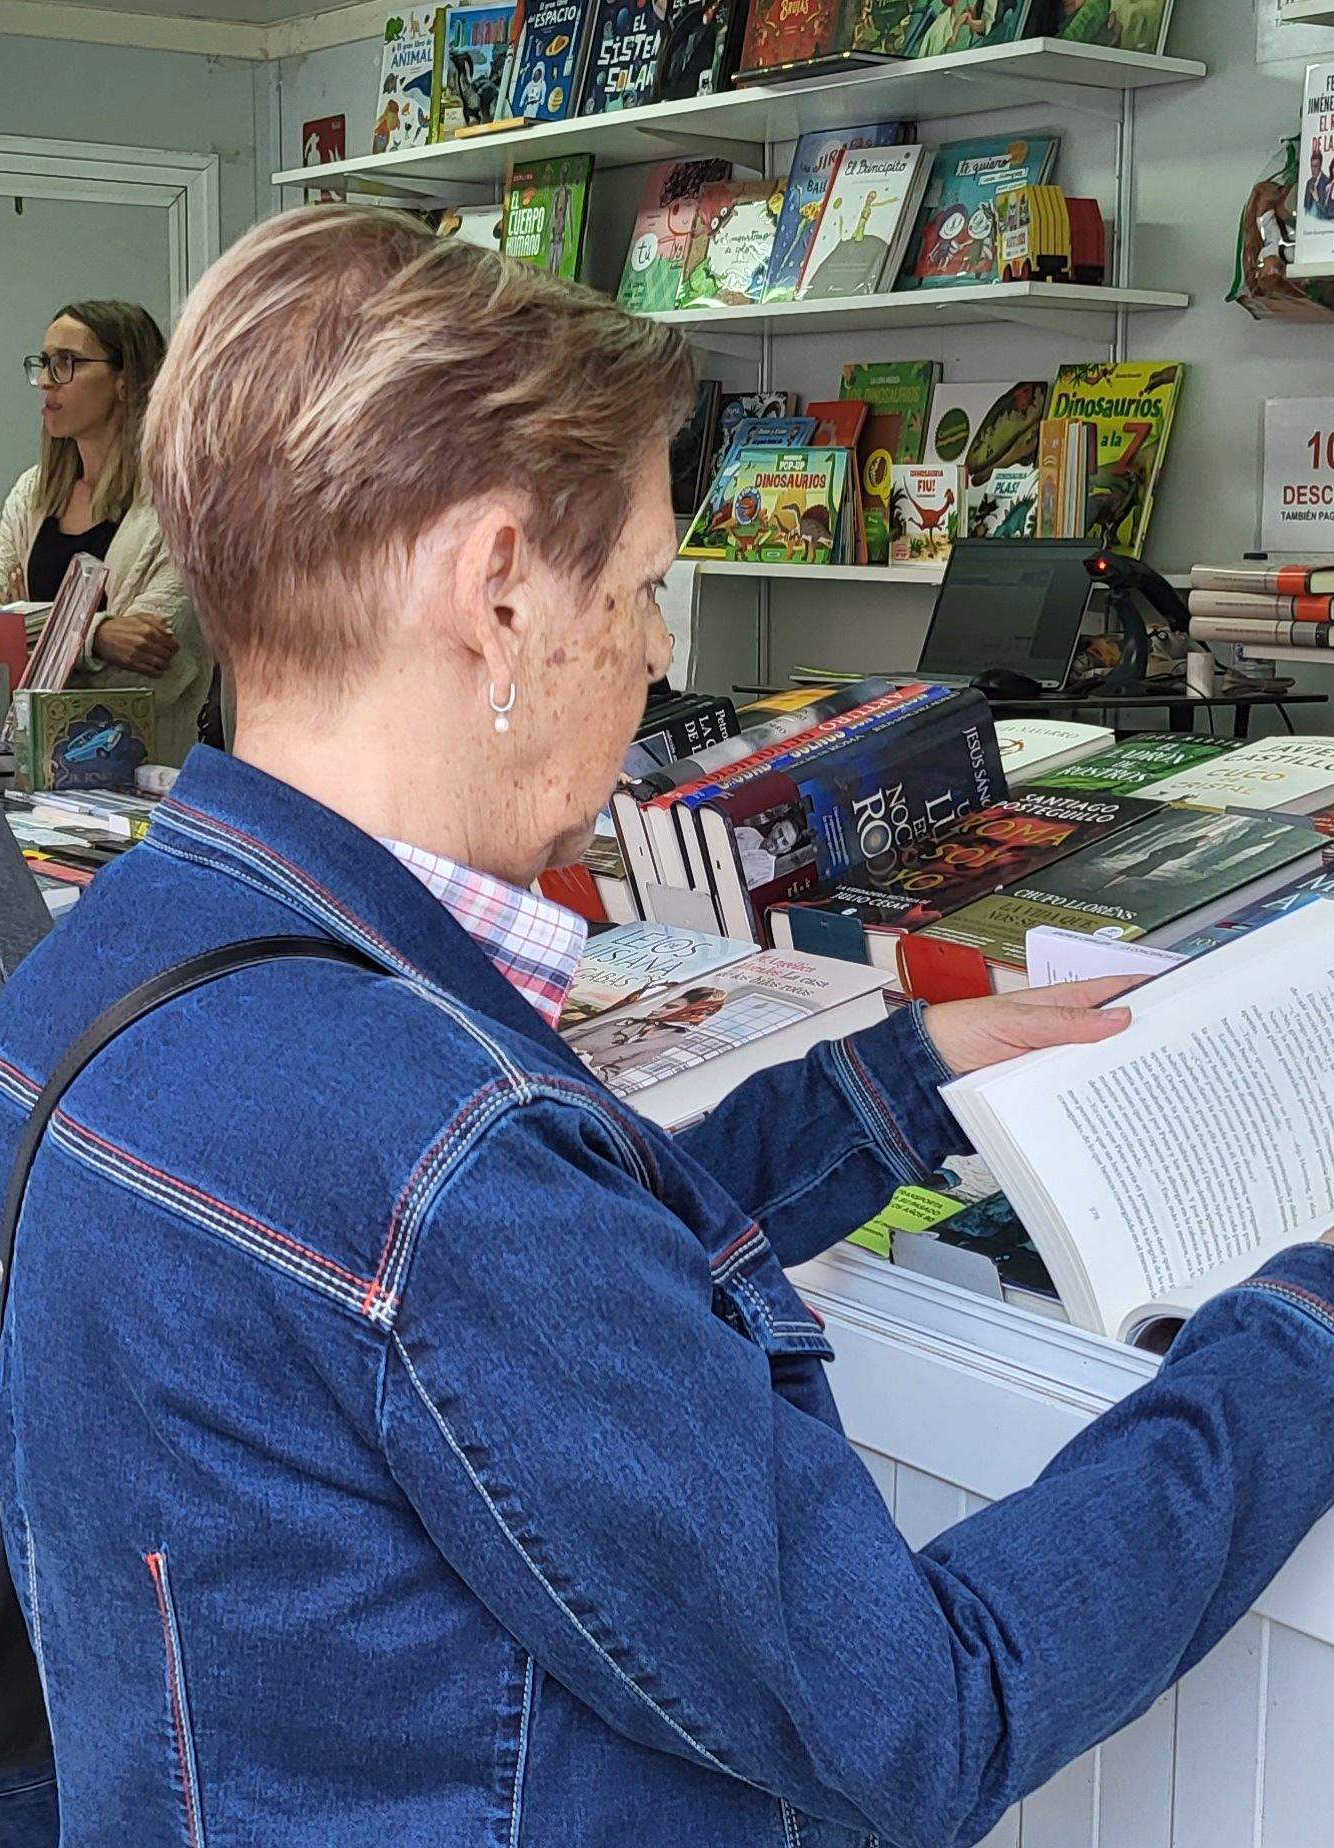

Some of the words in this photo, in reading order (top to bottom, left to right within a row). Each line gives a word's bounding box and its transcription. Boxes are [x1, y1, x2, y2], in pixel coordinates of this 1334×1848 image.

[534, 5, 577, 29] ESPACIO
[633, 13, 647, 32] EL
[1319, 117, 1329, 132] EL
[1312, 136, 1323, 152] DE
[1323, 134, 1334, 151] LA
[844, 160, 859, 175] El
[859, 157, 907, 178] Principito
[511, 190, 520, 208] EL
[507, 206, 546, 236] CUERPO
[506, 233, 541, 257] HUMANO
[1054, 393, 1162, 419] Dinosaurios
[755, 473, 827, 490] DINOSAURIOS
[917, 478, 936, 493] FIU!
[1280, 508, 1316, 523] TAMBIÉN
[819, 691, 904, 732] ARTURO
[685, 720, 697, 742] DE
[698, 715, 710, 733] LA
[962, 726, 986, 772] JESÚS
[1057, 765, 1151, 783] ROSTROS
[1207, 768, 1287, 782] CUCO
[973, 770, 995, 808] SÁNC
[992, 799, 1116, 824] POSTEGUILLO
[1018, 793, 1120, 815] SANTIAGO
[955, 816, 1077, 847] ROMA
[919, 842, 1014, 868] SOY
[884, 868, 946, 892] YO
[832, 891, 870, 905] JULIO
[871, 895, 912, 911] CÉSAR
[1059, 914, 1100, 928] QUE
[611, 928, 714, 958] LEJOS
